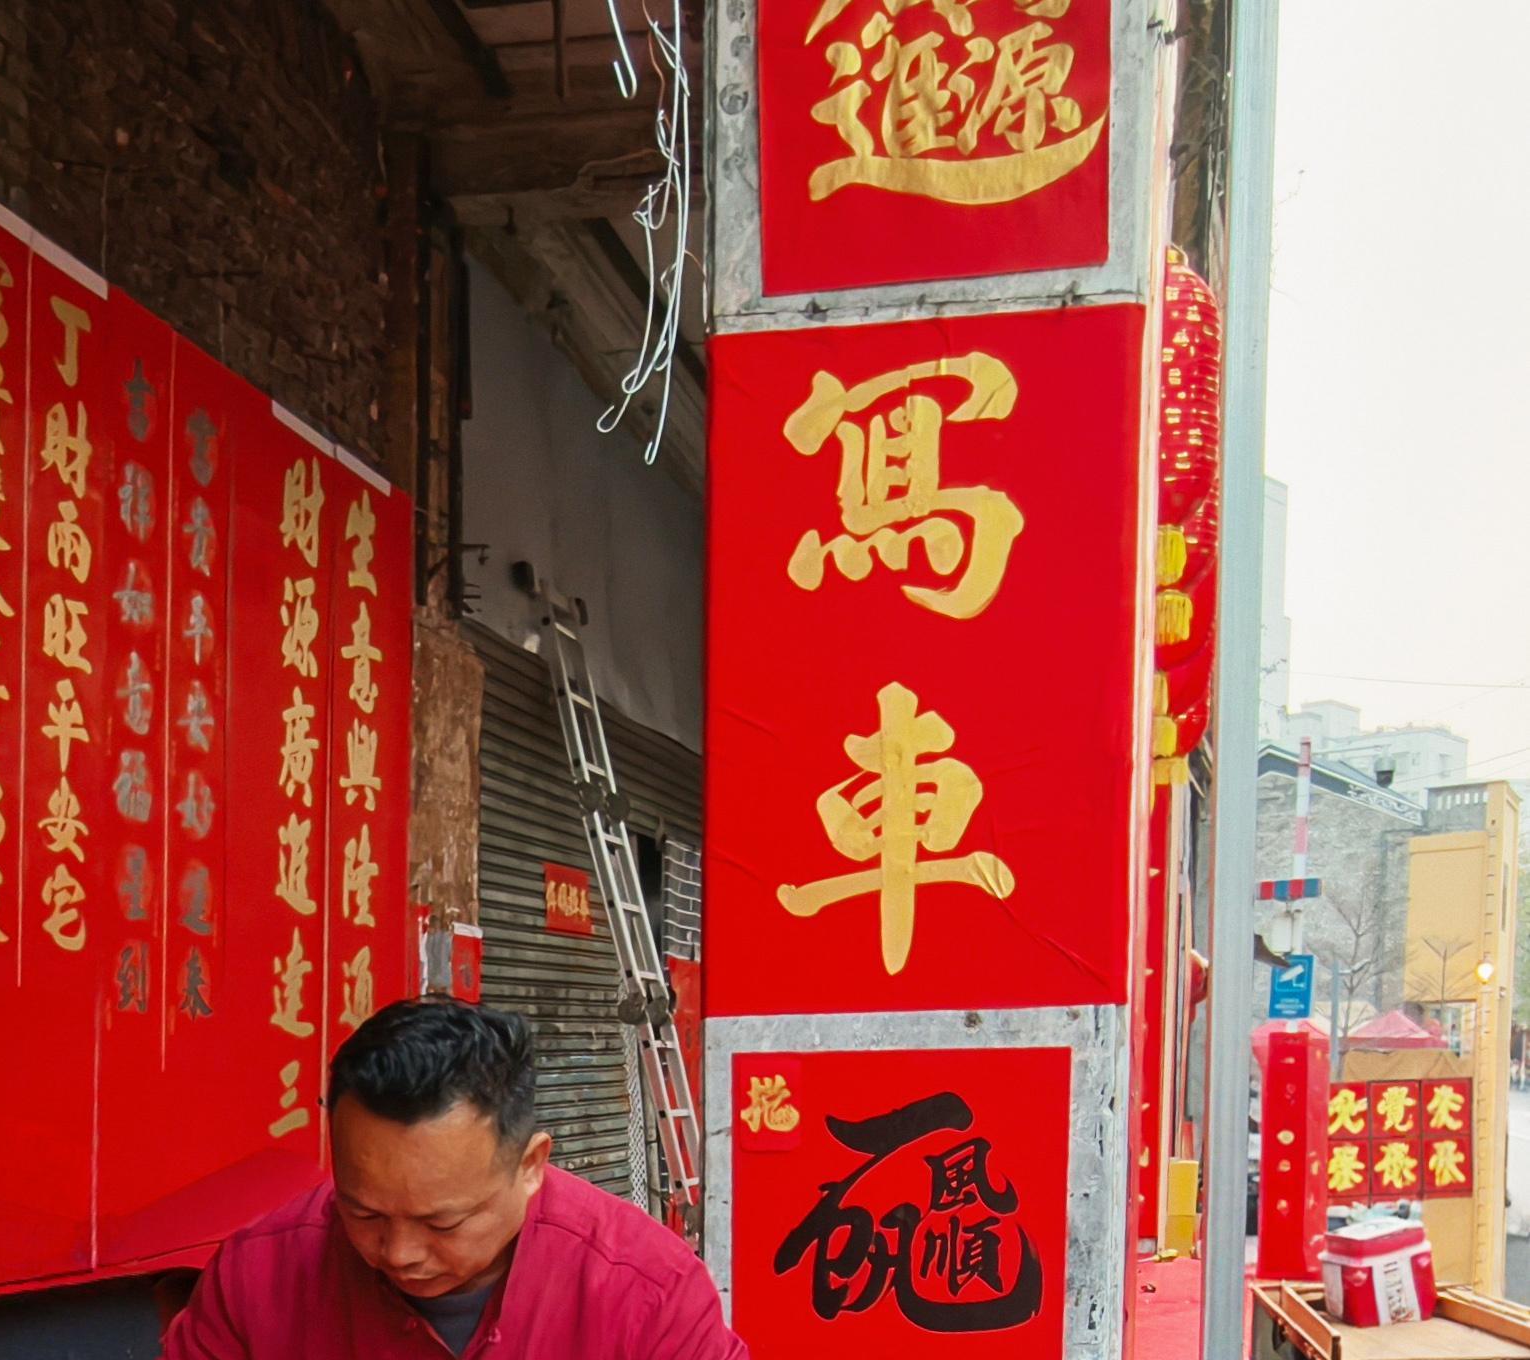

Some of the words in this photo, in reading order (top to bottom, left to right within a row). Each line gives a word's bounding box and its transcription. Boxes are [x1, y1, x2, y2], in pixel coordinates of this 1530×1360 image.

[38, 295, 93, 952] 丁財兩旺平安宅
